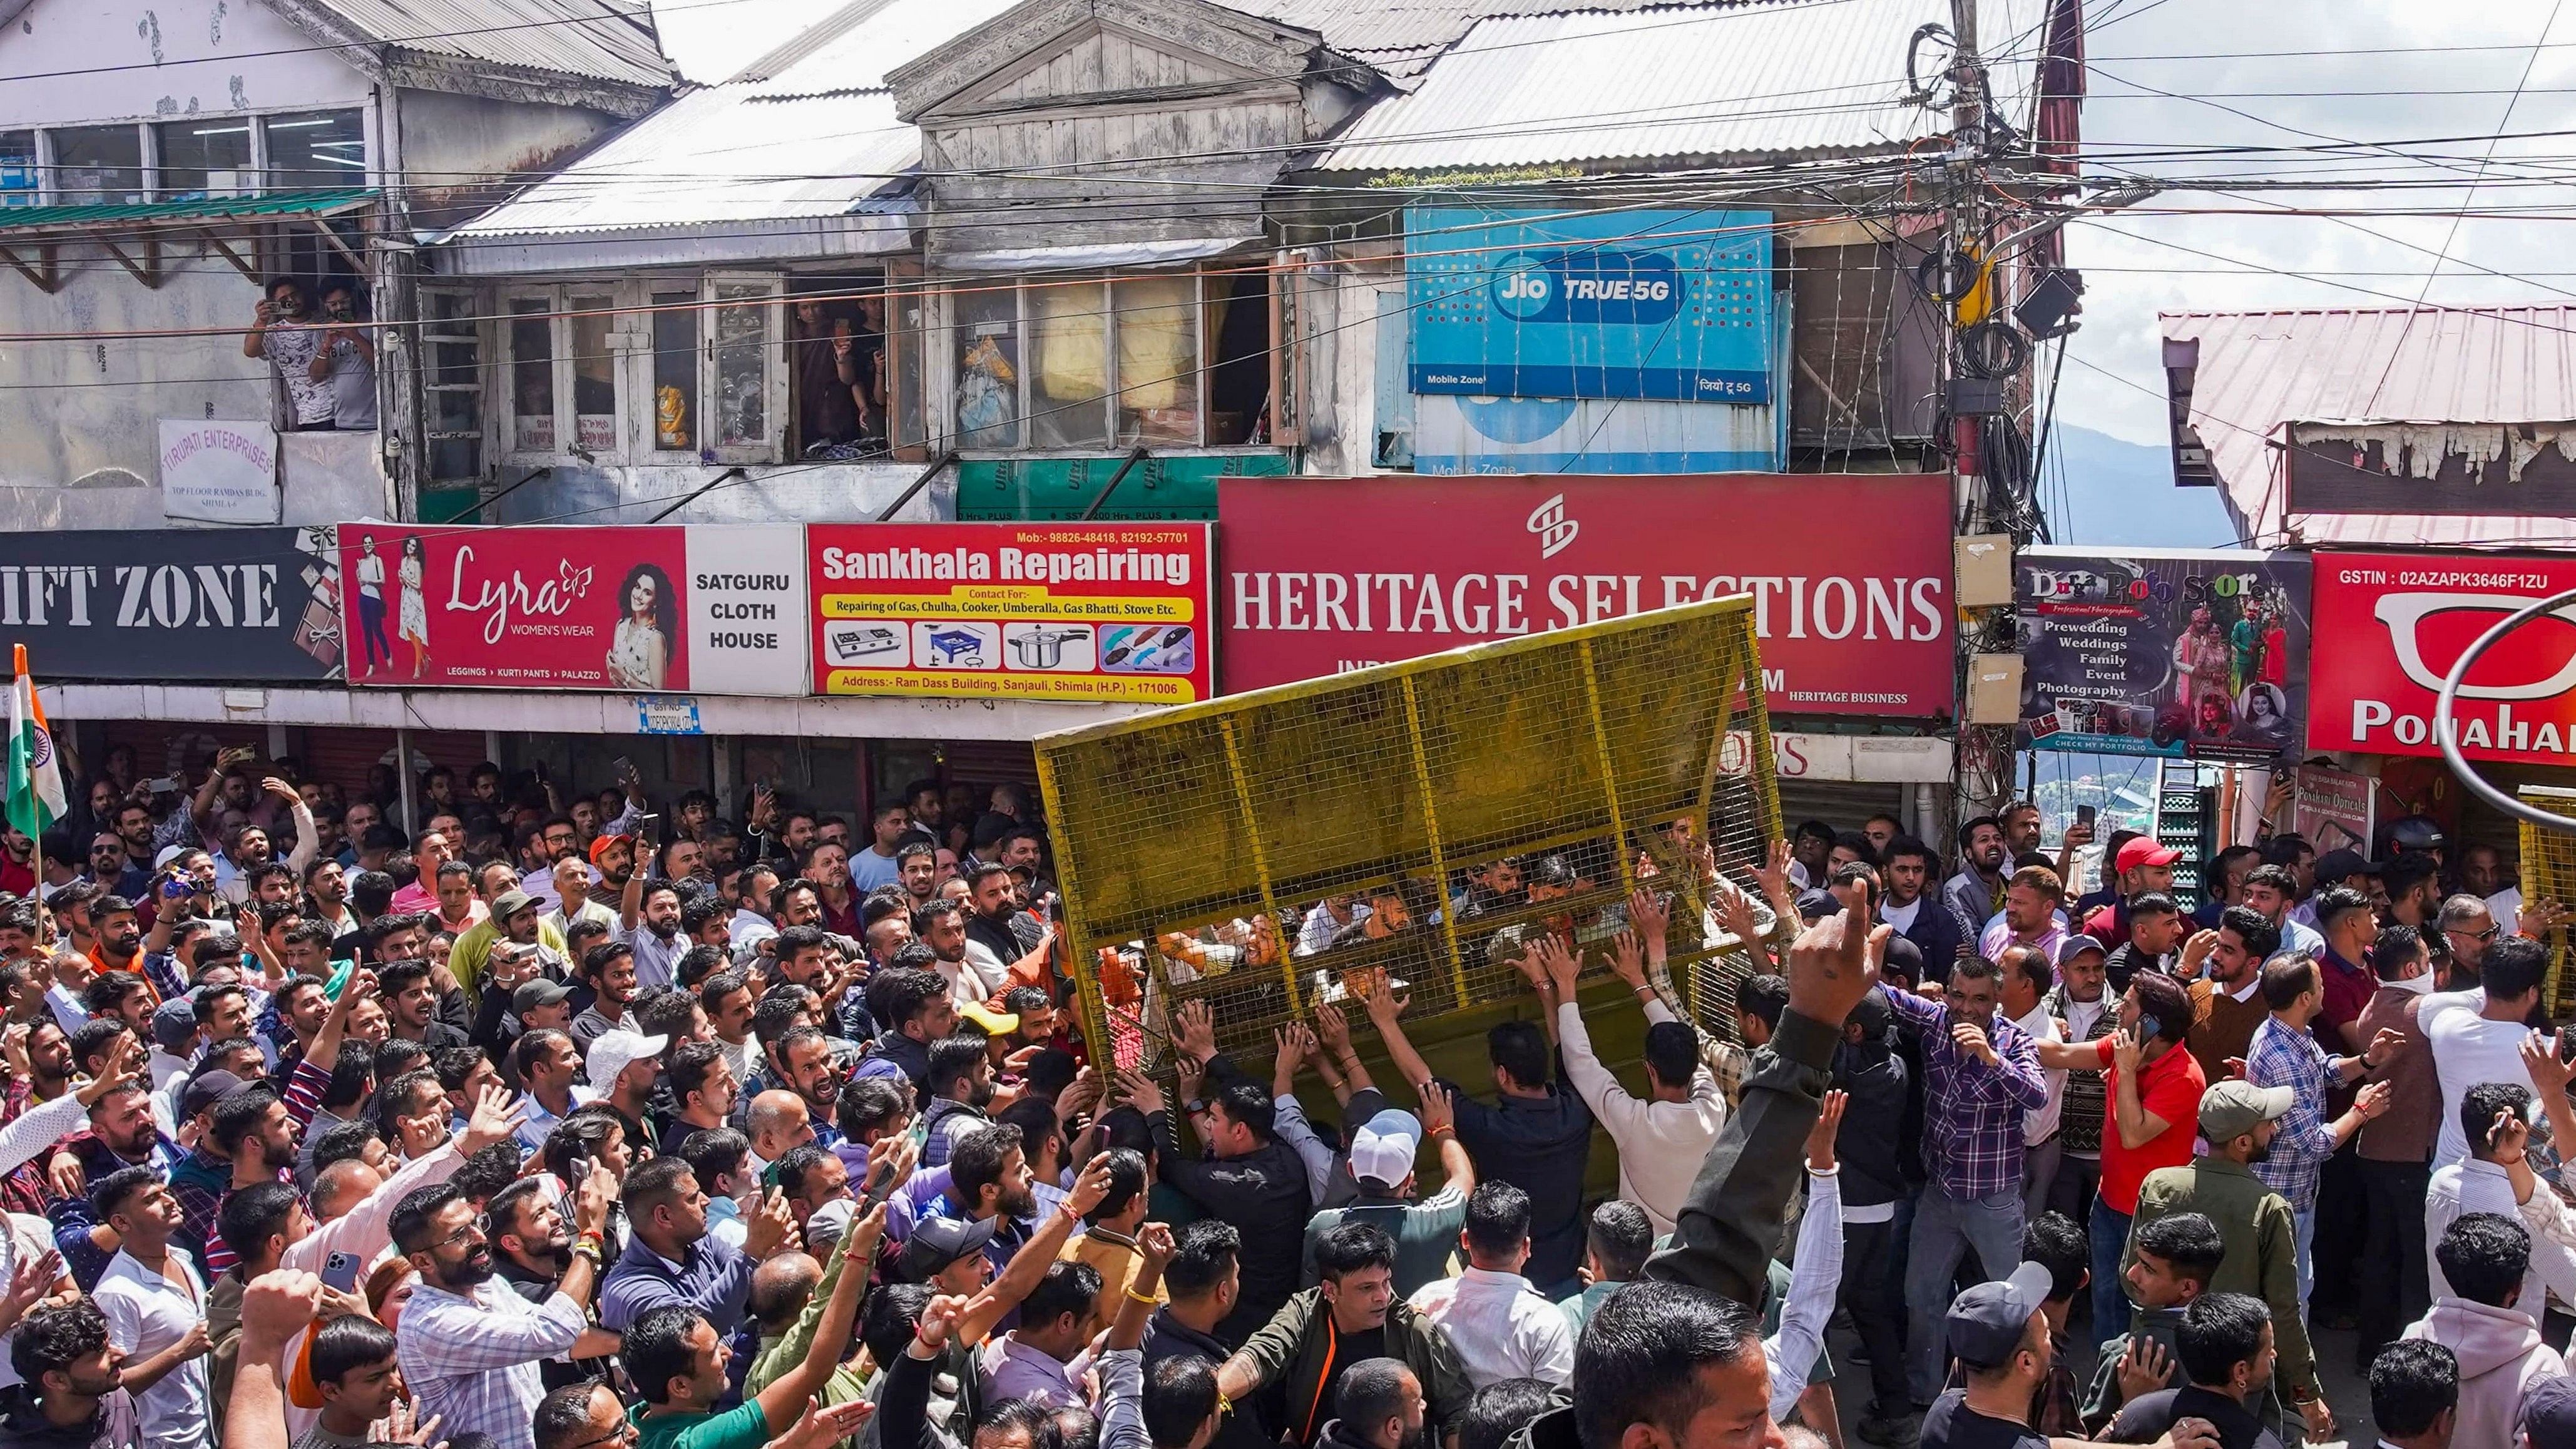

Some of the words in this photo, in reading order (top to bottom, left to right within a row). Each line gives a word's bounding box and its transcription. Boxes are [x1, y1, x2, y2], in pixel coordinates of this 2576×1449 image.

[1501, 273, 1546, 300] Jio
[1564, 280, 1630, 300] TRUE
[1632, 280, 1670, 301] 5G
[1428, 375, 1459, 384] Mobile
[1460, 375, 1484, 384] Zone
[1699, 377, 1724, 392] जियो
[1735, 382, 1751, 393] 5G
[163, 432, 202, 471] TIRUPATI
[203, 429, 270, 473] ENTERPRISES
[187, 487, 212, 496] FLOOR
[1136, 512, 1162, 520] PLUS
[1016, 532, 1048, 543] Mob:-
[1050, 532, 1118, 545] 98826-48418,
[1120, 532, 1188, 543] 82192-57701
[822, 547, 991, 580] Sankhala
[999, 547, 1190, 585] Repairing
[696, 574, 790, 591] SATGURU
[2339, 570, 2386, 585] GSTIN
[2400, 571, 2548, 589] 02AZAPK3646F1ZU
[116, 565, 280, 628] ZONE
[446, 545, 571, 645] Lyra
[969, 588, 1005, 599] Contact
[1006, 589, 1030, 599] For:-
[836, 601, 886, 614] Repairing
[887, 602, 898, 612] of
[899, 602, 919, 614] Gas,
[921, 601, 960, 615] Chulha,
[962, 602, 1001, 615] Cooker,
[1003, 603, 1061, 616] Umberalla,
[1064, 604, 1083, 614] Gas
[1086, 603, 1122, 616] Bhatti,
[1124, 605, 1154, 615] Stove
[1157, 605, 1177, 616] Etc.
[1231, 571, 1530, 635] HERITAGE
[710, 603, 776, 620] CLOTH
[511, 625, 560, 636] WOMEN'S
[563, 625, 595, 637] WEAR
[2045, 621, 2127, 636] Prewedding
[710, 632, 778, 649] HOUSE
[2059, 637, 2127, 652] Weddings
[2080, 653, 2127, 667] Family
[447, 667, 487, 677] LEGGINGS
[497, 668, 521, 678] KURTI
[523, 669, 550, 678] PANTS
[561, 670, 601, 680] PALAZZO
[2085, 669, 2127, 681] Event
[842, 676, 893, 687] Address:-
[896, 678, 918, 688] Ram
[921, 678, 949, 689] Dass
[951, 678, 1000, 692] Building,
[1003, 680, 1051, 694] Sanjauli,
[1055, 680, 1093, 692] Shimla
[1096, 681, 1127, 695] (H.P.)
[1137, 684, 1178, 695] 171006
[2037, 683, 2127, 699] Photography
[1789, 692, 1848, 703] HERITAGE
[1851, 692, 1908, 704] BUSINESS
[2100, 743, 2147, 751] PORTFOLIO
